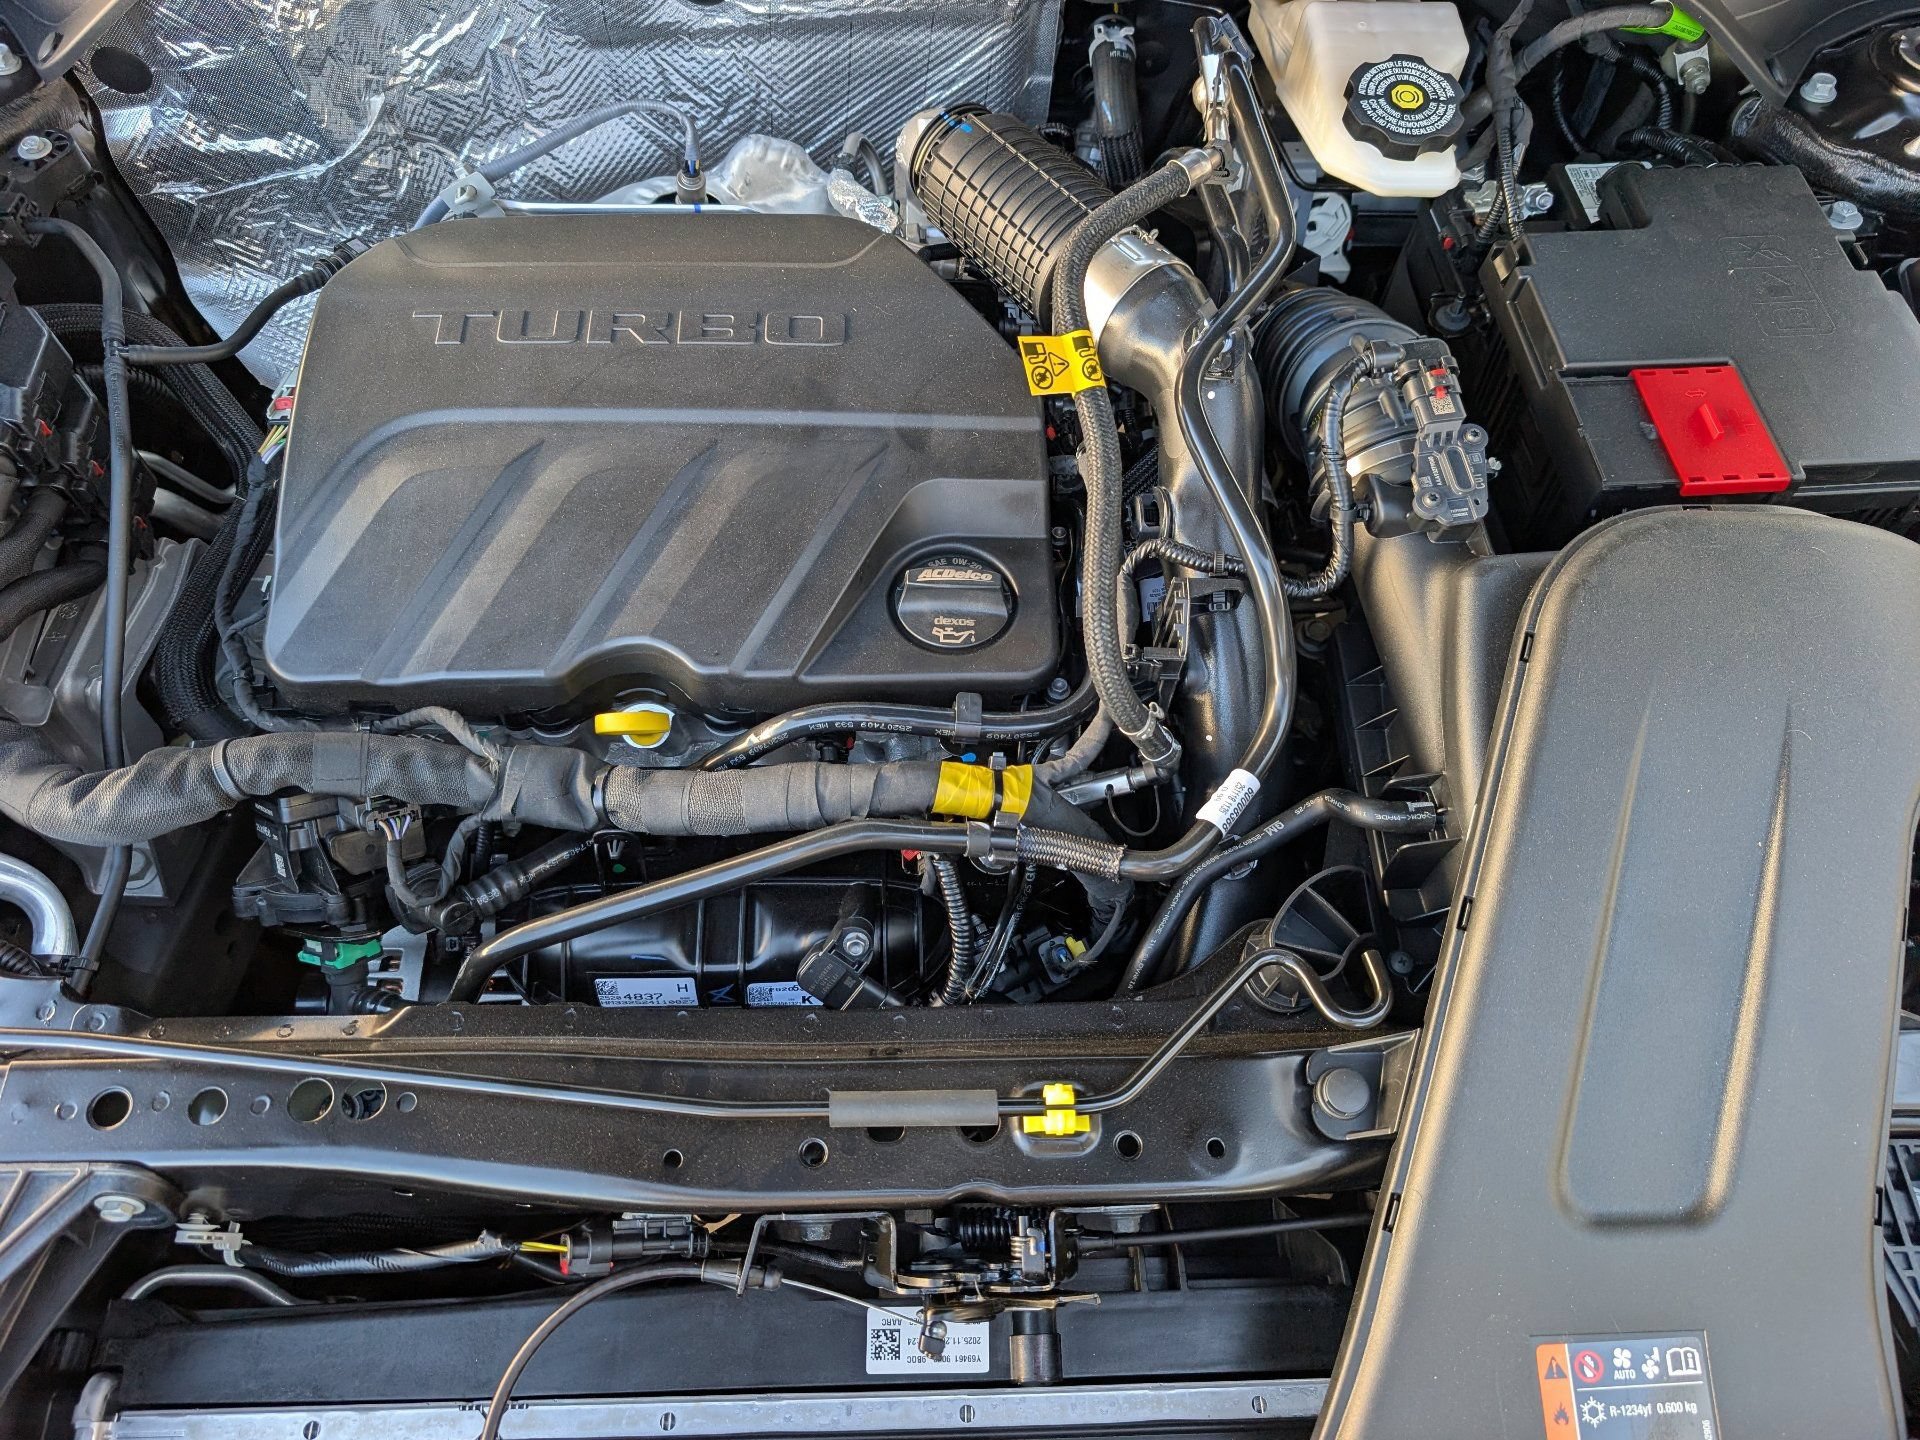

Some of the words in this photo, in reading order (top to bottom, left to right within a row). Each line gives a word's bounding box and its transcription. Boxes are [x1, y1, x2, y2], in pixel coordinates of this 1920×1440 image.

[1401, 60, 1429, 72] BOUCHON
[1374, 107, 1398, 125] BEFORE
[1403, 112, 1425, 121] CLEAN
[1421, 101, 1439, 117] FILLER
[1367, 111, 1387, 127] FLUID
[1384, 122, 1405, 134] FROM
[1411, 124, 1437, 135] SEALED
[412, 310, 851, 347] TURBO
[917, 568, 994, 583] ACDelco
[934, 616, 977, 627] dexos
[808, 722, 829, 732] MEX
[860, 721, 913, 732] 25207409
[985, 730, 1040, 742] 25207409
[1263, 820, 1285, 837] GM
[676, 983, 689, 993] H
[623, 992, 663, 1001] 4837
[801, 996, 813, 1004] K
[881, 1318, 902, 1326] AARC
[1613, 1369, 1636, 1380] AUTO
[1609, 1403, 1652, 1418] R-1234yf
[1656, 1402, 1683, 1414] 0.600
[1684, 1400, 1698, 1414] kg
